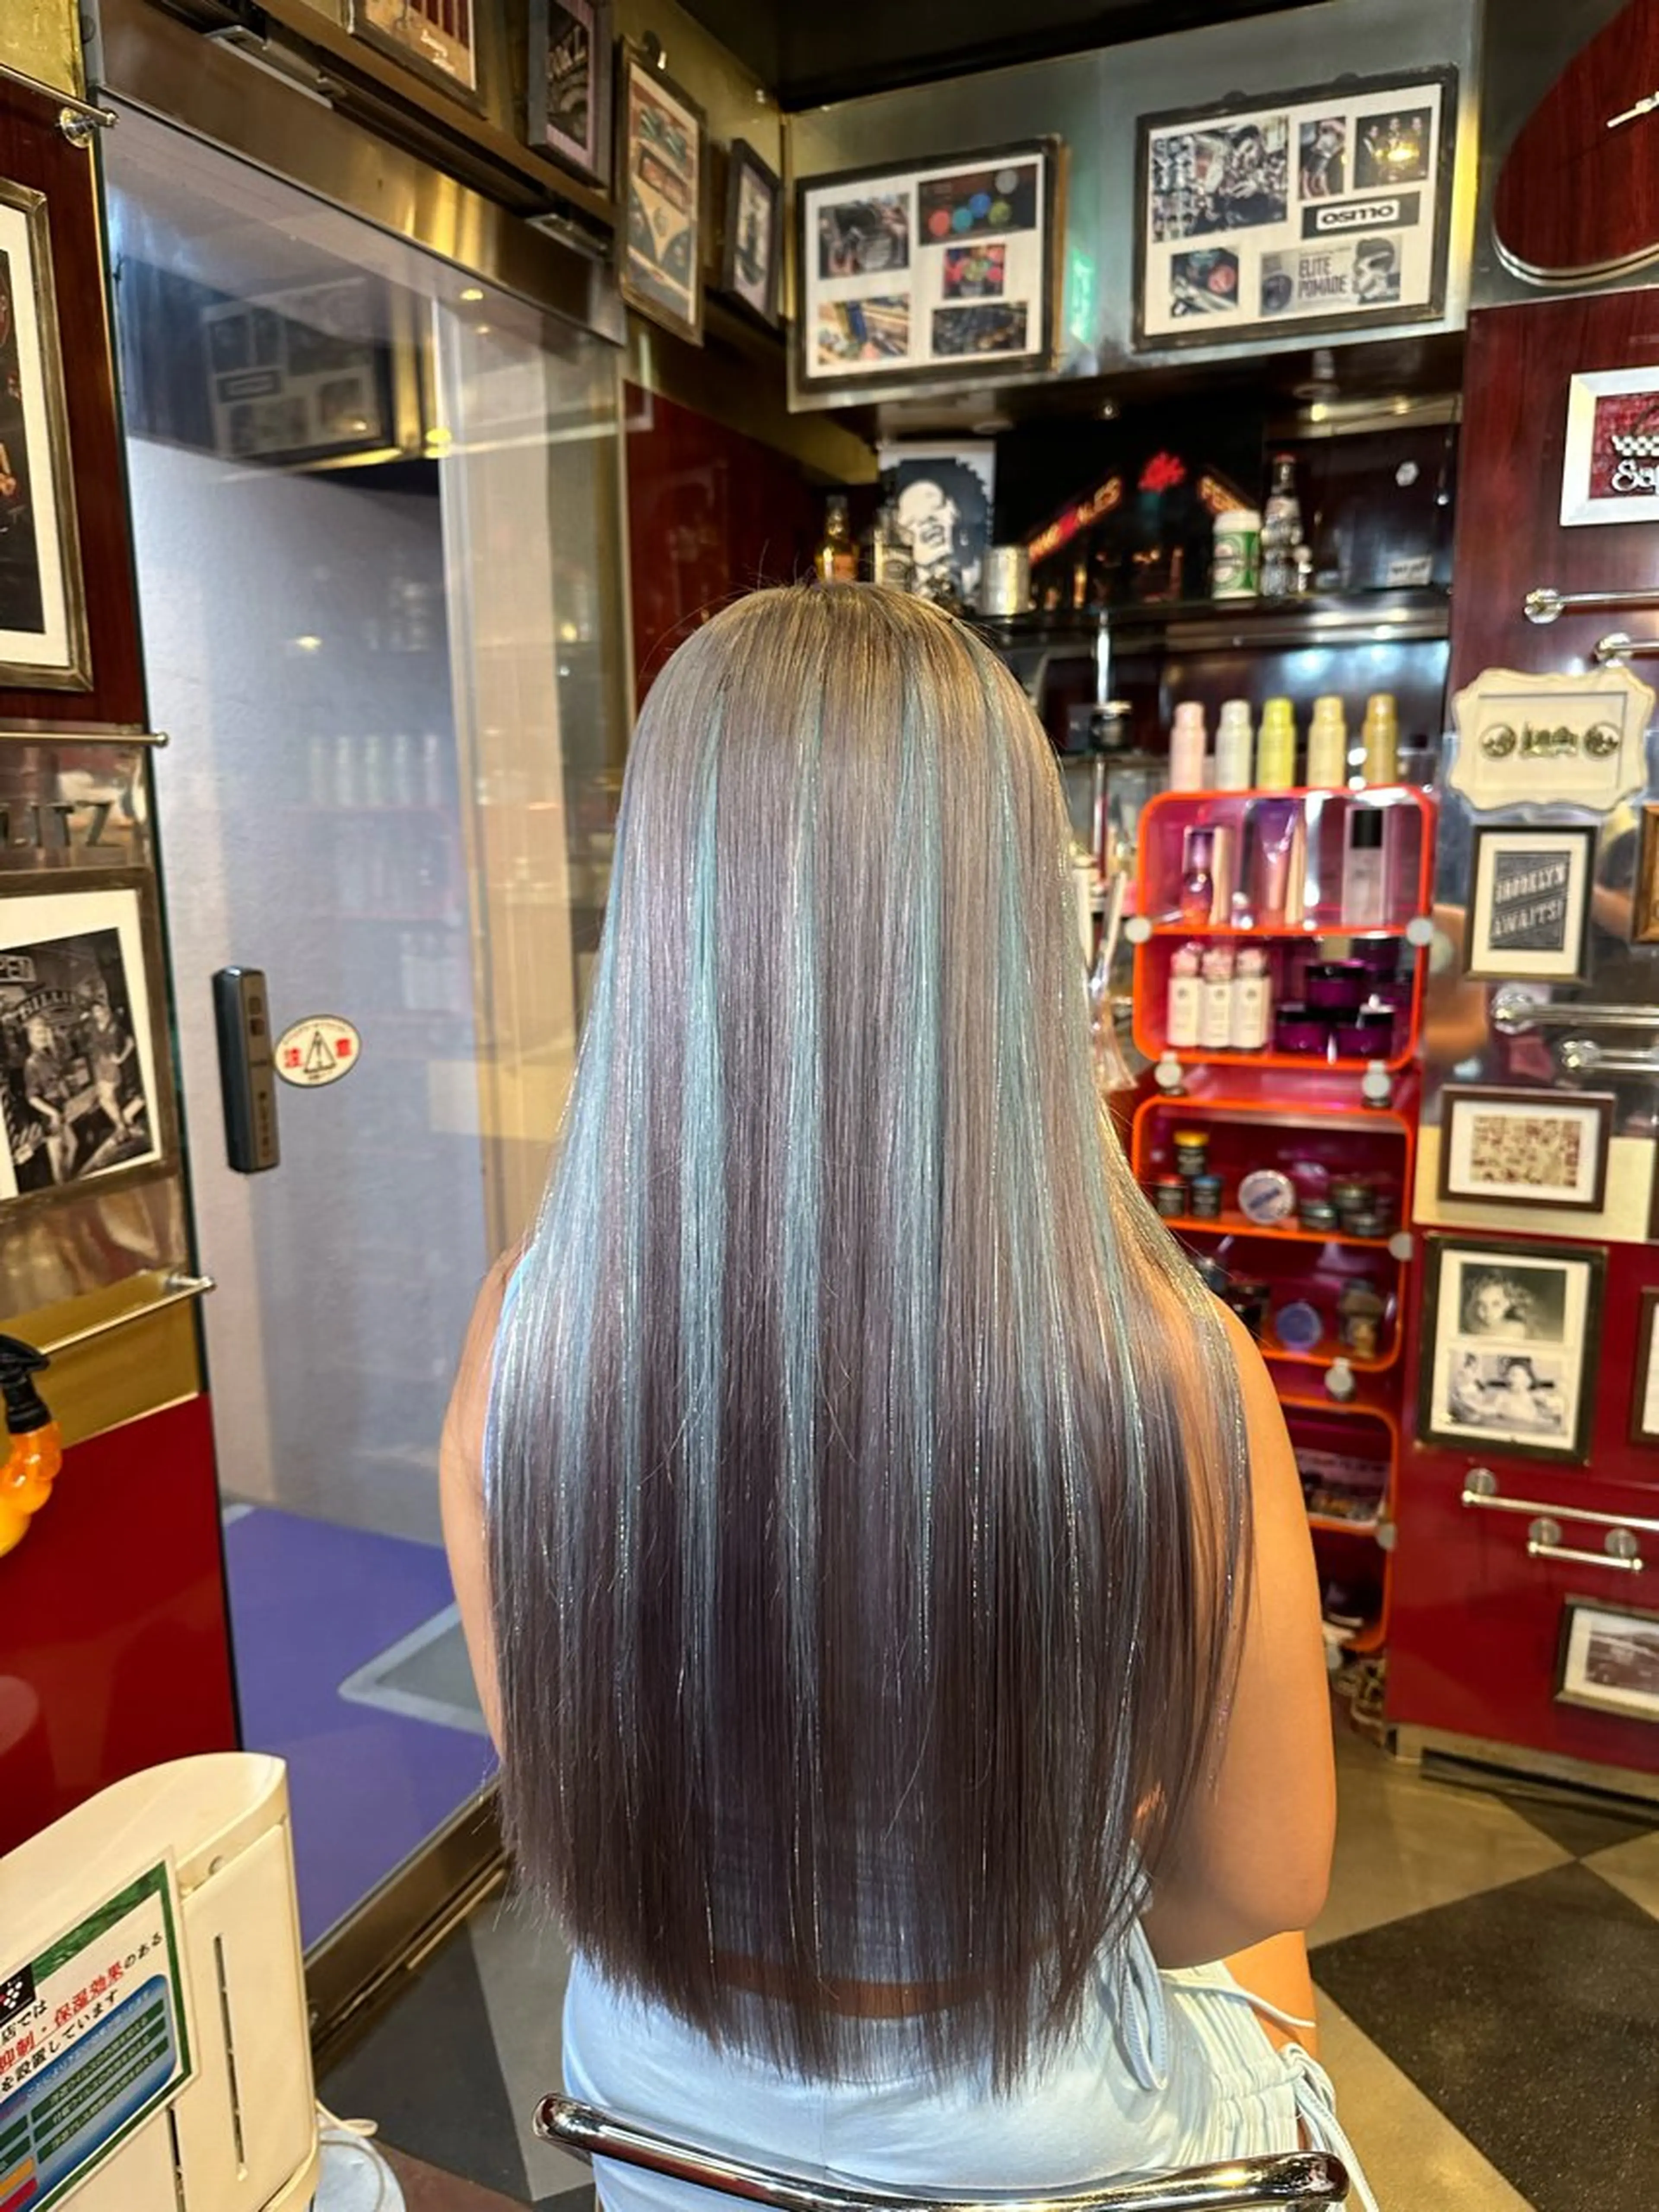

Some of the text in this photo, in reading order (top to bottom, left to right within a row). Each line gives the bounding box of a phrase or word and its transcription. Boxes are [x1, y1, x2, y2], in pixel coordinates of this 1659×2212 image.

[1299, 256, 1332, 278] ELITE
[1298, 274, 1348, 298] POMADE
[1495, 864, 1566, 904] BROOKLYN
